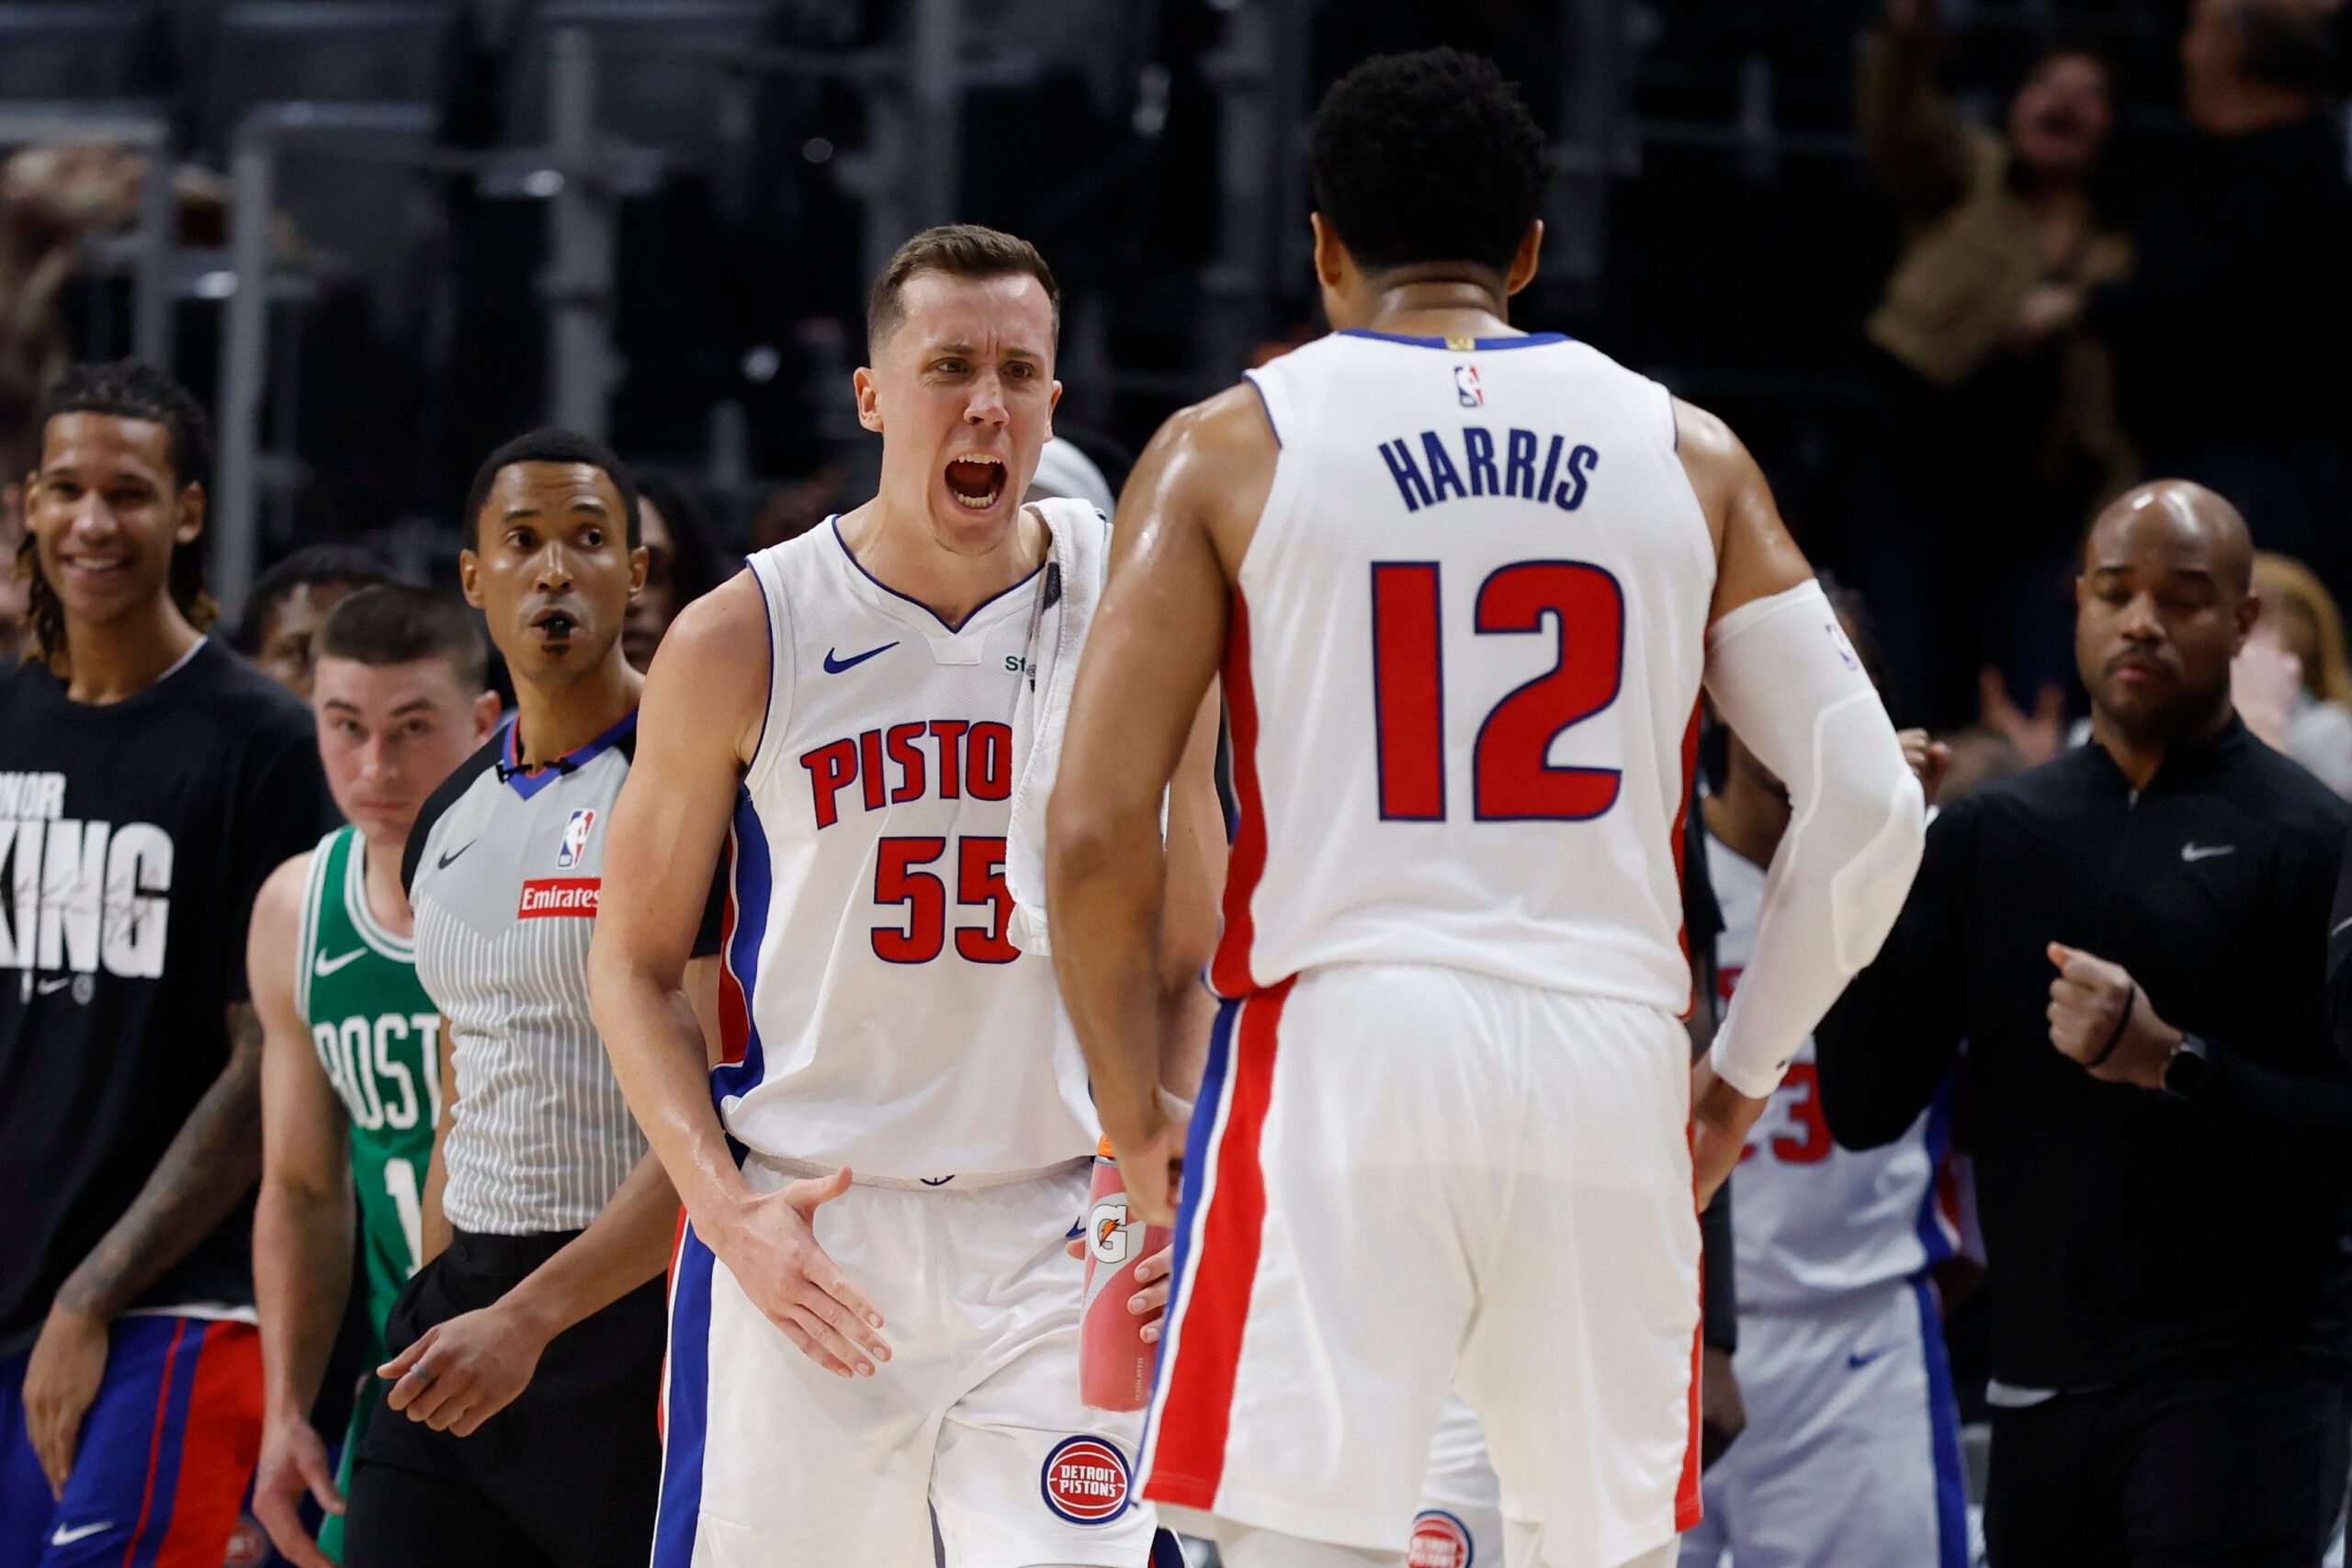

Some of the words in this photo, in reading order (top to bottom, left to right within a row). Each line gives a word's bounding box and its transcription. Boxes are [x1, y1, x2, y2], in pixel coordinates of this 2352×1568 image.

[1378, 426, 1600, 513] HARRIS
[1370, 558, 1625, 822] 12
[0, 771, 66, 821] NOR
[799, 719, 1012, 830] PISTO
[521, 884, 600, 911] Emirates
[870, 835, 1022, 964] 55
[1089, 1203, 1128, 1264] G
[1058, 1479, 1117, 1498] PISTONS
[1059, 1464, 1117, 1483] DETROIT
